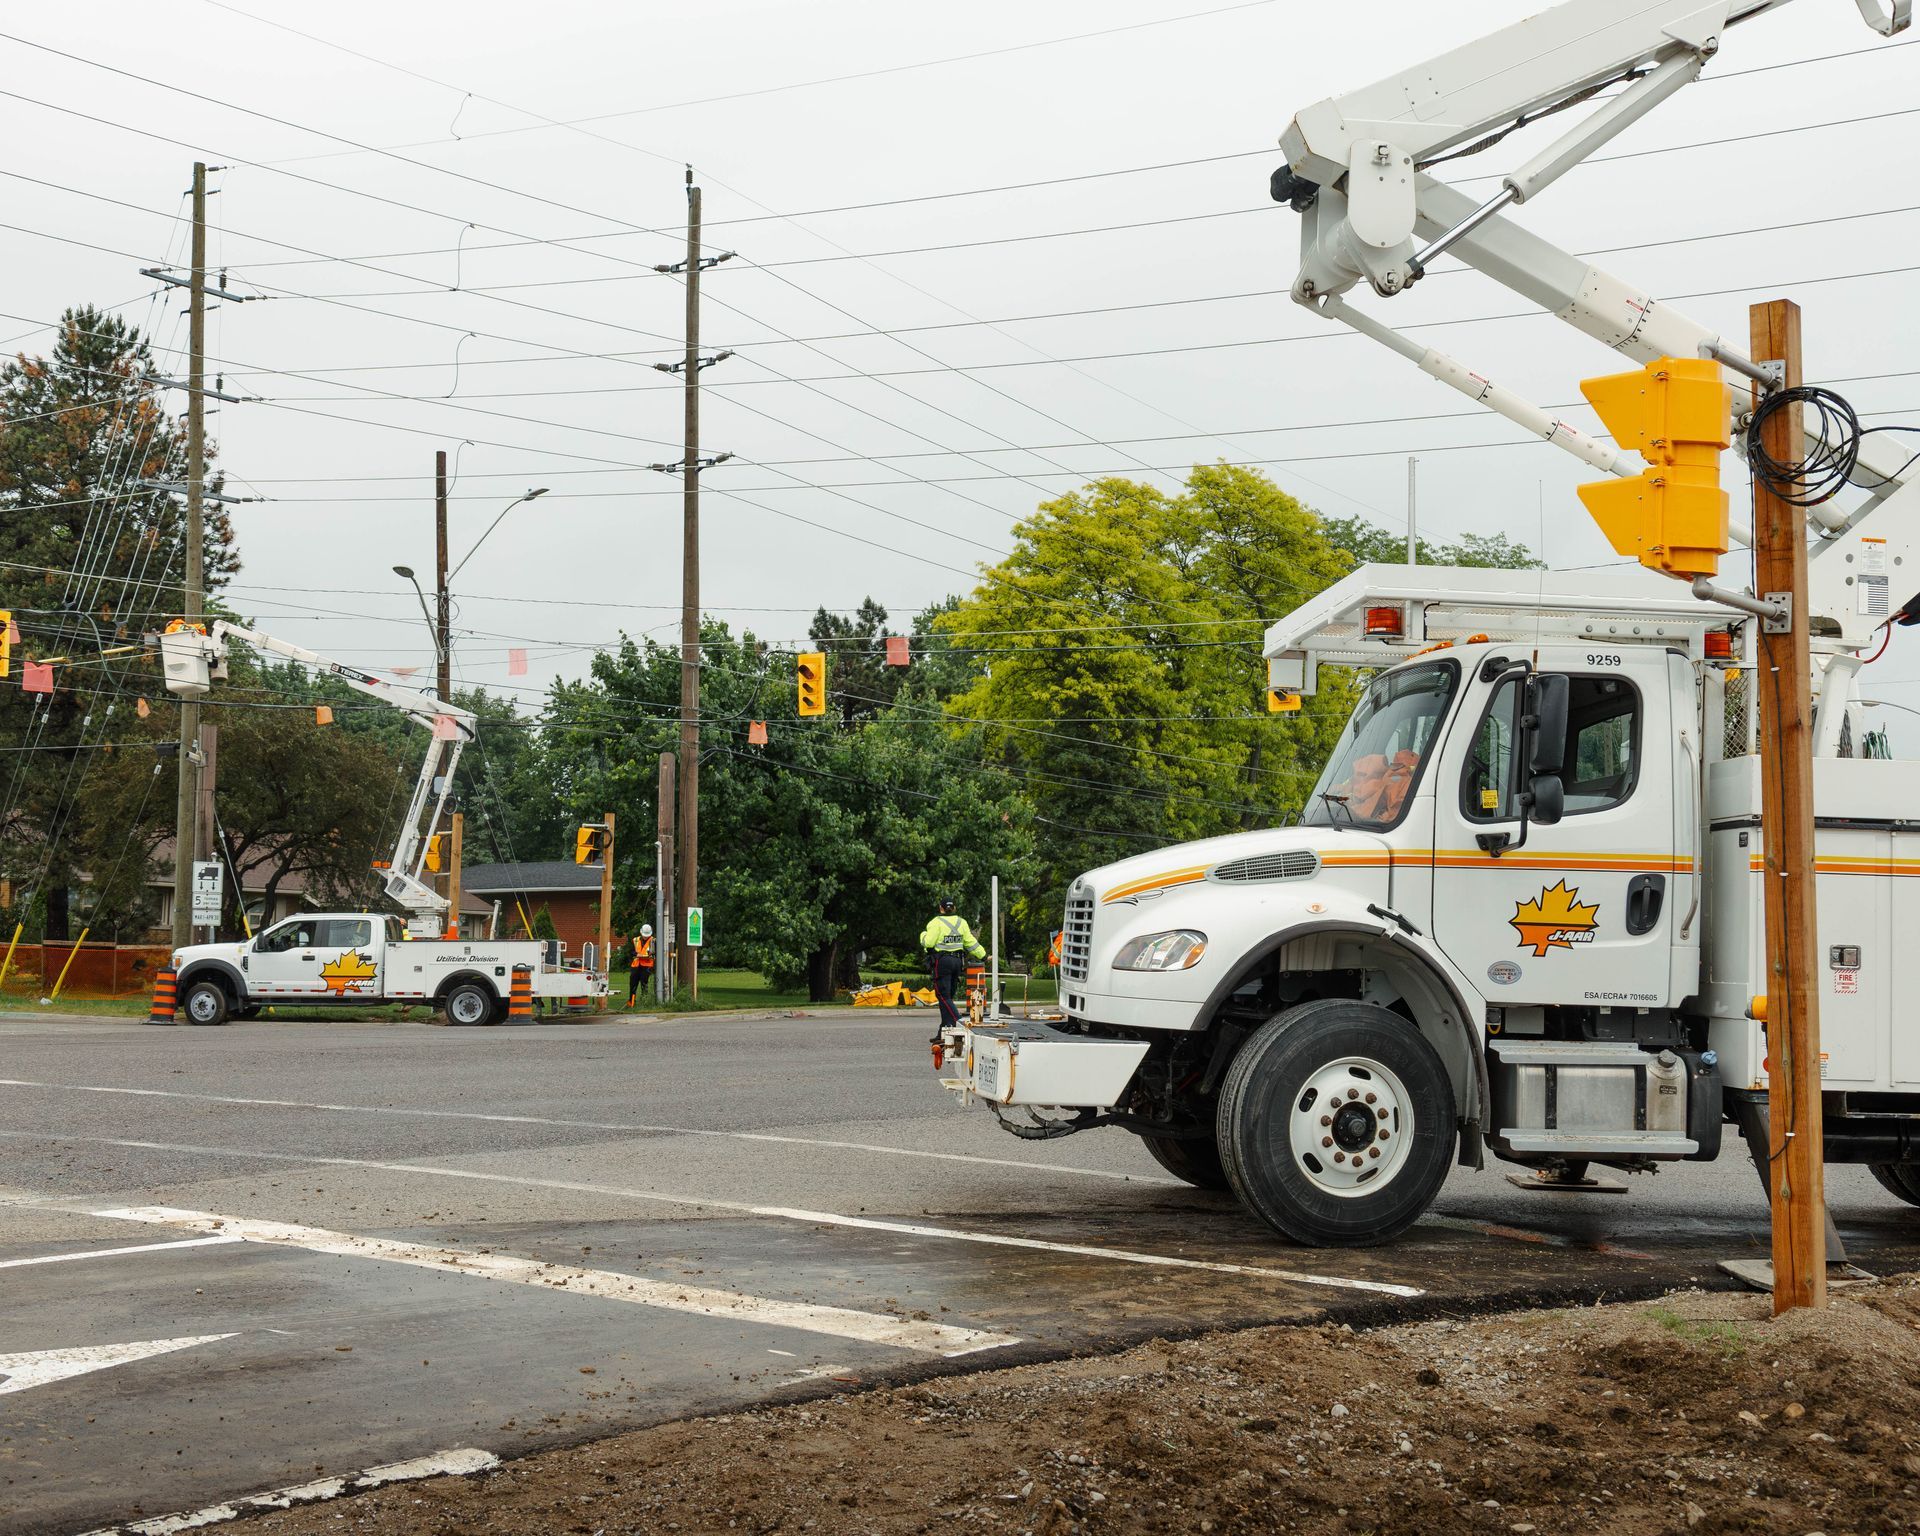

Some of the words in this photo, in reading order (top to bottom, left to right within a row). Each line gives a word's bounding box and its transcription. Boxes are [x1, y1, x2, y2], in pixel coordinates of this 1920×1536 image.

[1586, 654, 1621, 666] 9259
[340, 667, 364, 680] TEREX
[195, 896, 201, 905] 5
[1547, 930, 1594, 942] J-AAR
[1584, 991, 1628, 1000] ESA/ECRA#
[1629, 993, 1658, 1001] 7016605
